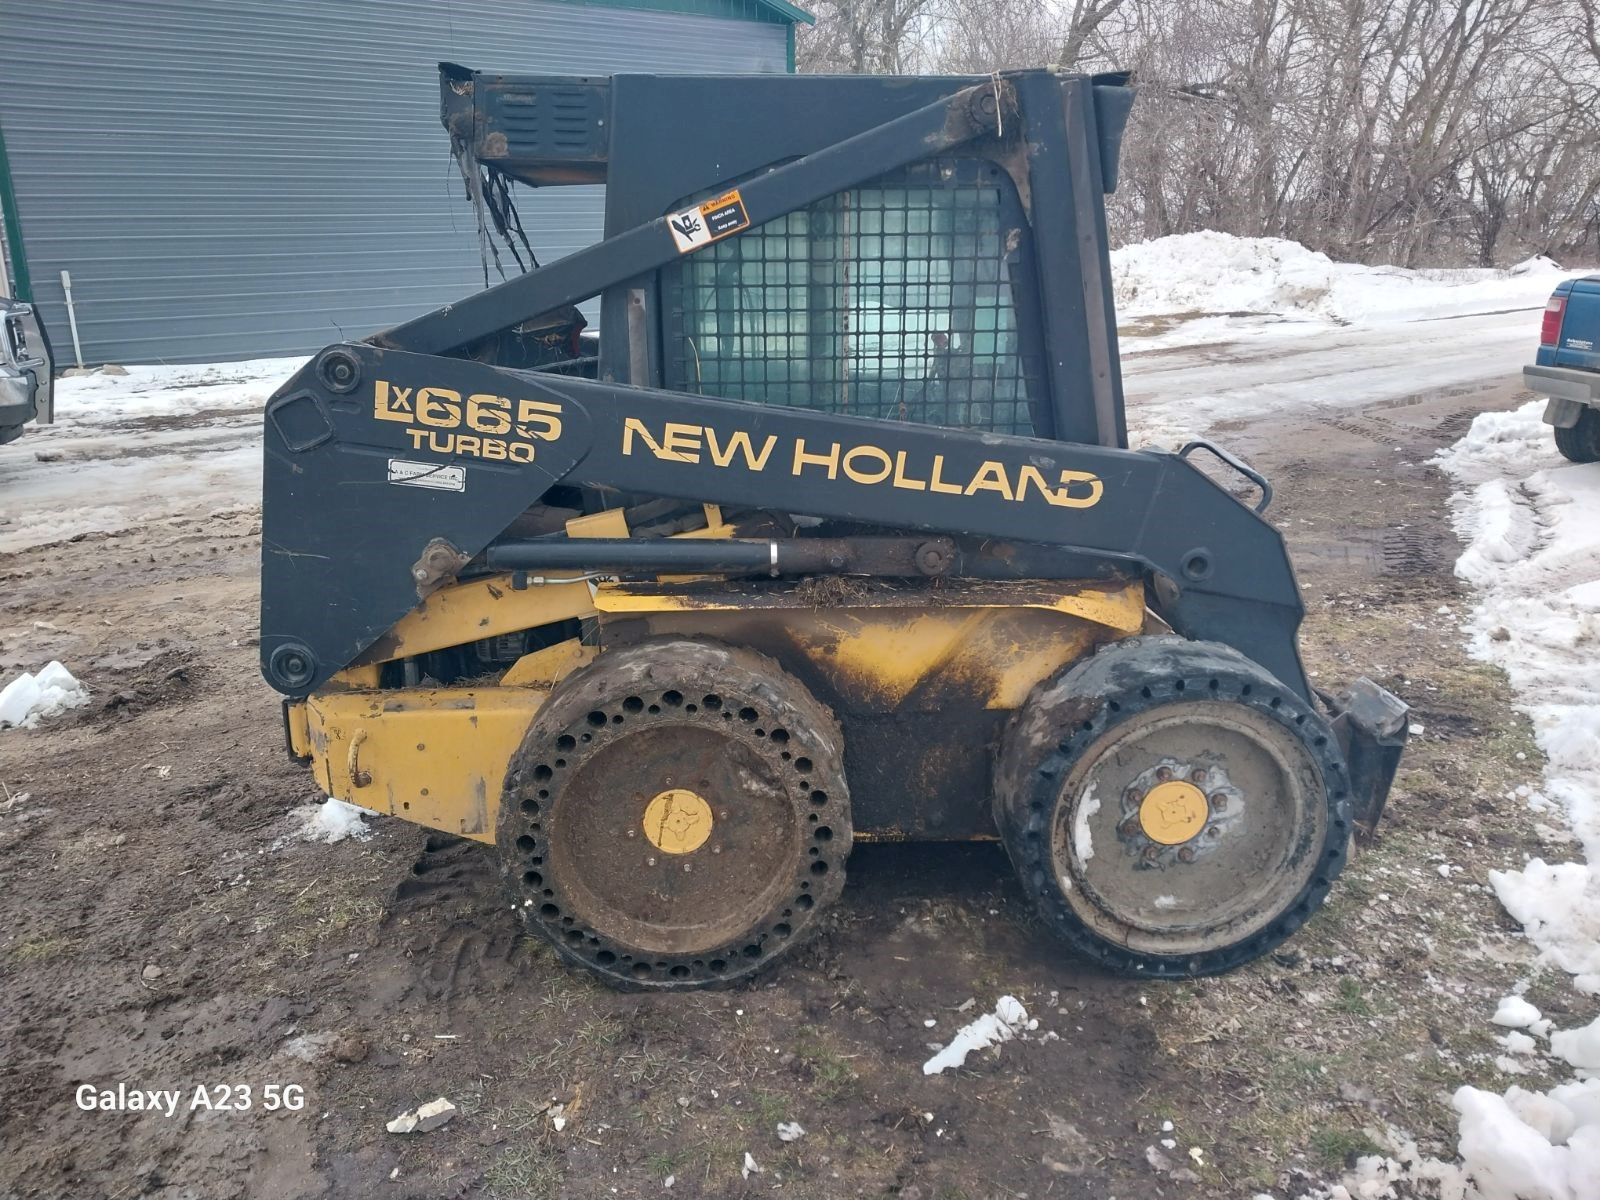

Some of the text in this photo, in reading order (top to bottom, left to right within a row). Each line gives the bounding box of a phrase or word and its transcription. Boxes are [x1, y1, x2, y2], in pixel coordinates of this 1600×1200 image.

[406, 428, 535, 463] TURBO
[622, 417, 1103, 508] NEW HOLLAND
